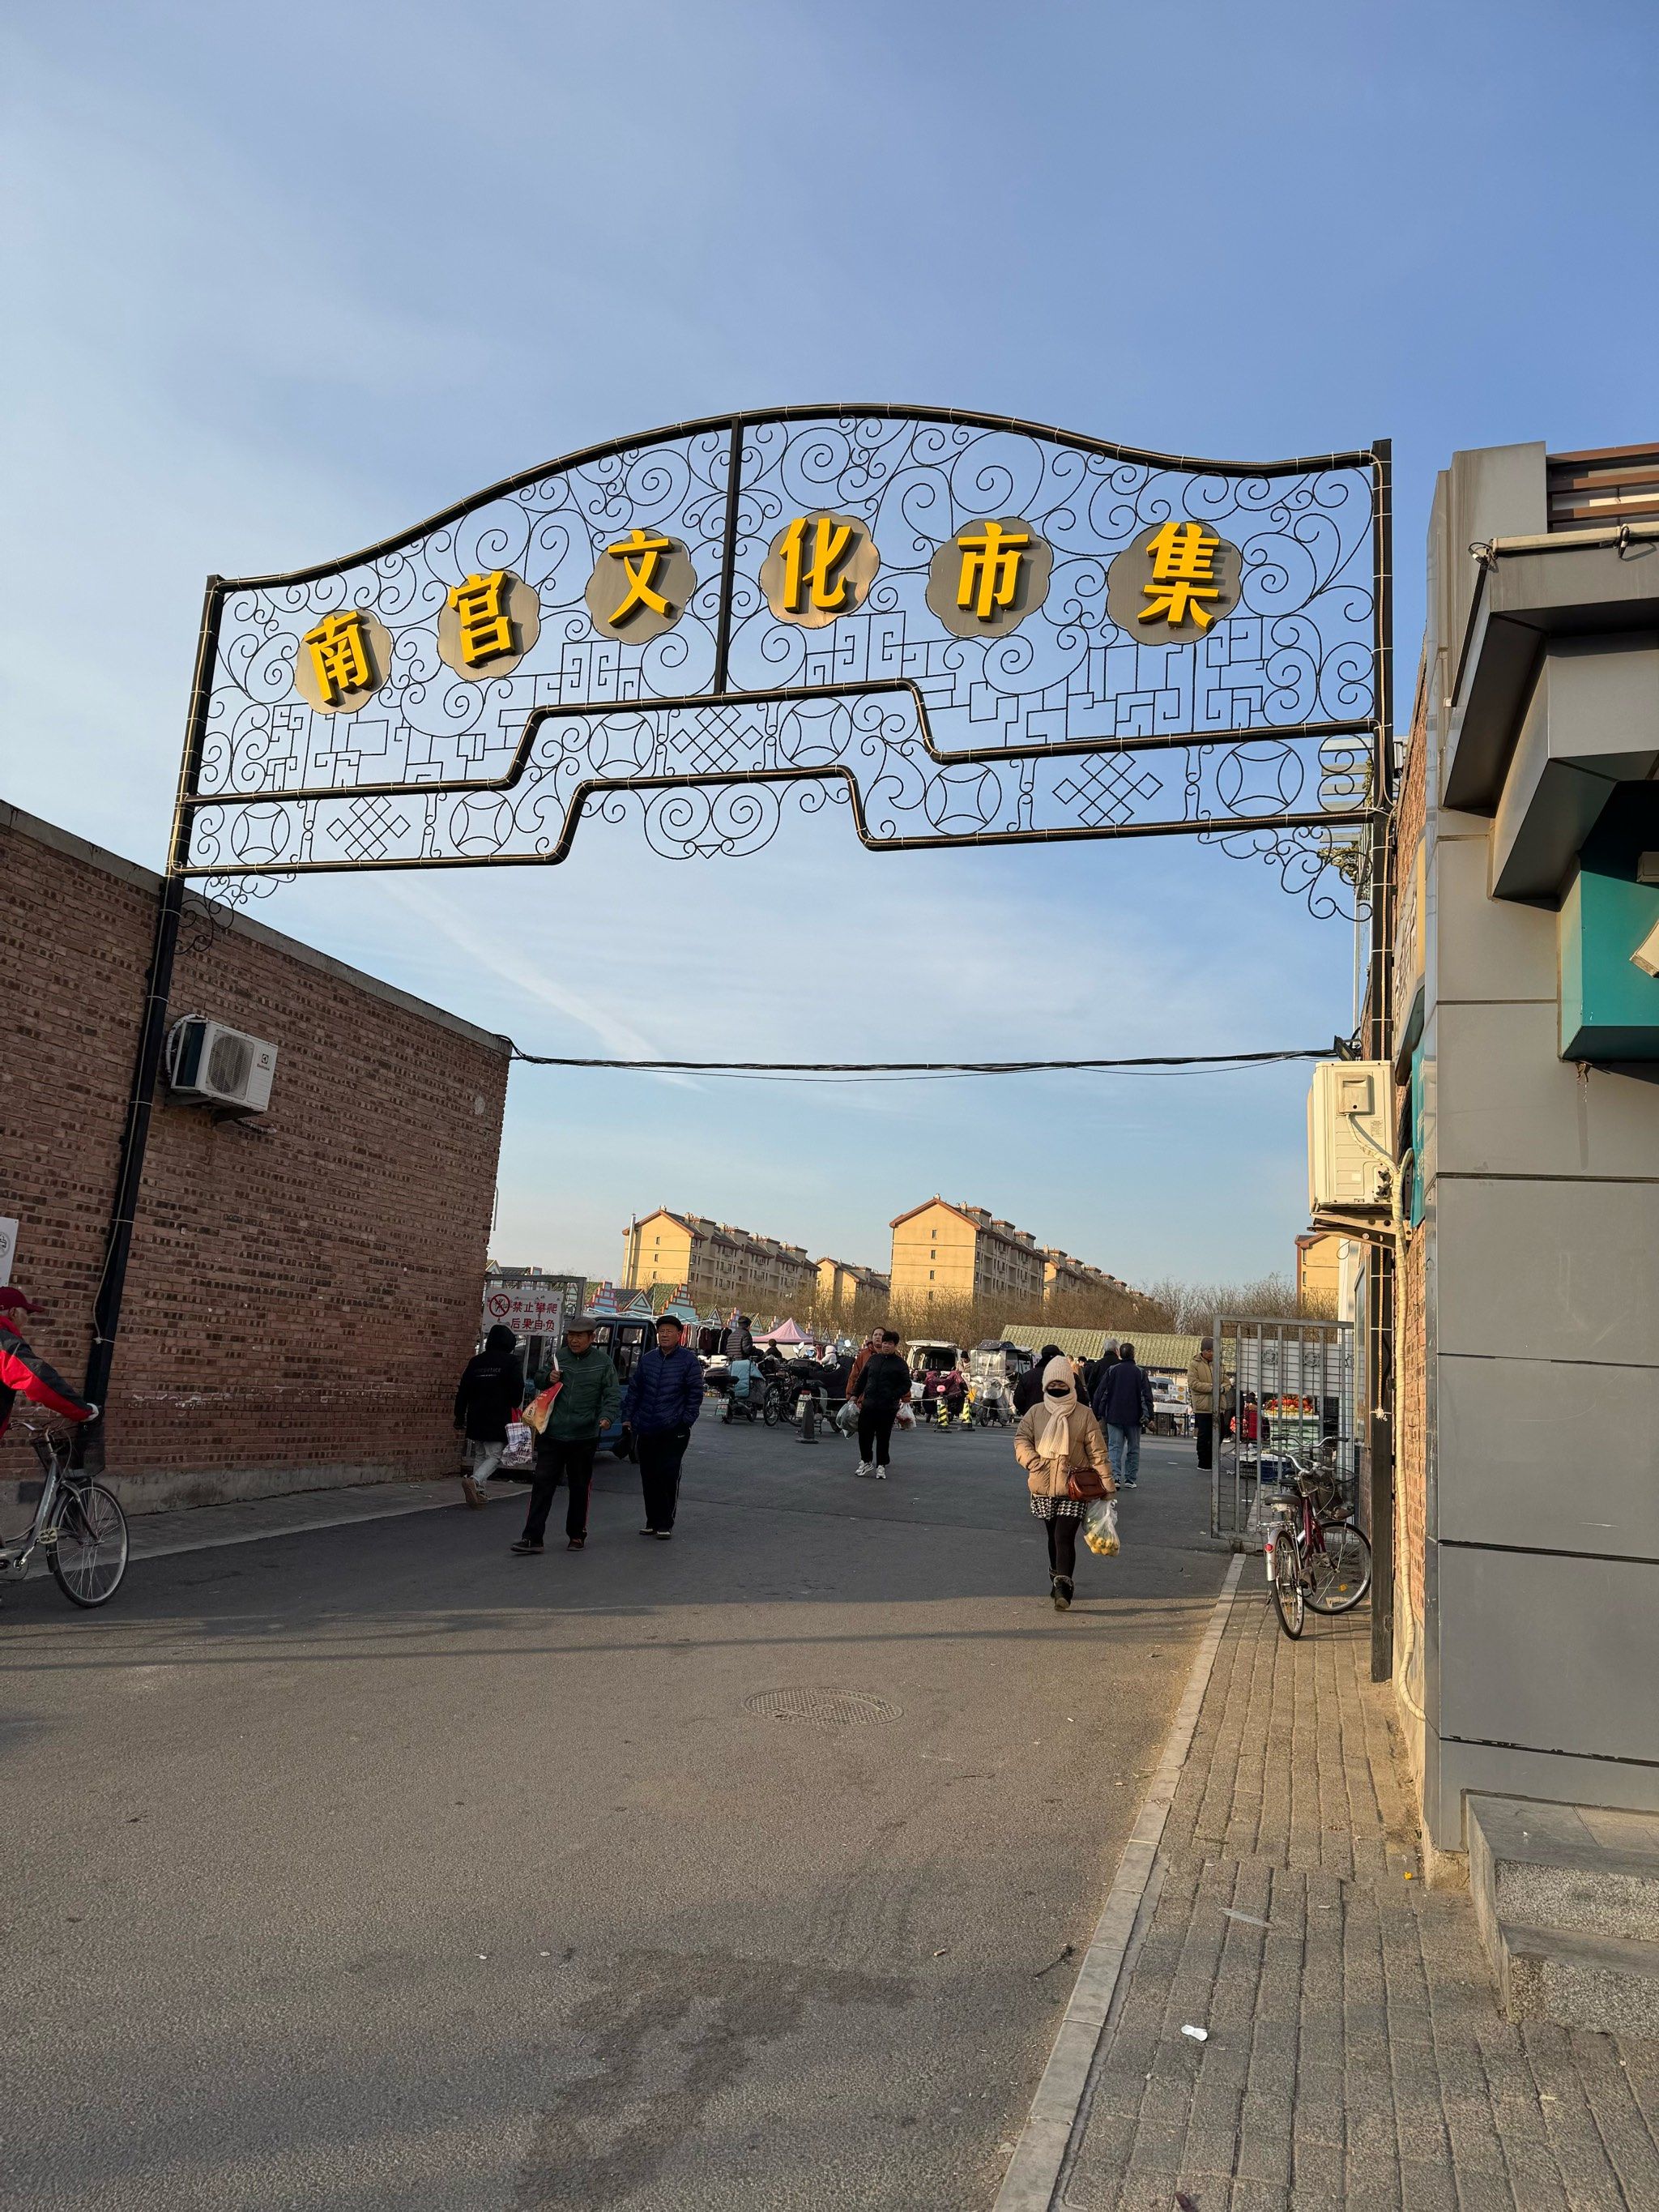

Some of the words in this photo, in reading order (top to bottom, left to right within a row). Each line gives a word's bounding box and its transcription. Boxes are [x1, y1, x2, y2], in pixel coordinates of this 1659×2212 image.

[304, 519, 1218, 706] 南宫文化市集
[512, 1301, 557, 1313] 禁止攀爬
[510, 1318, 554, 1330] 后果自负
